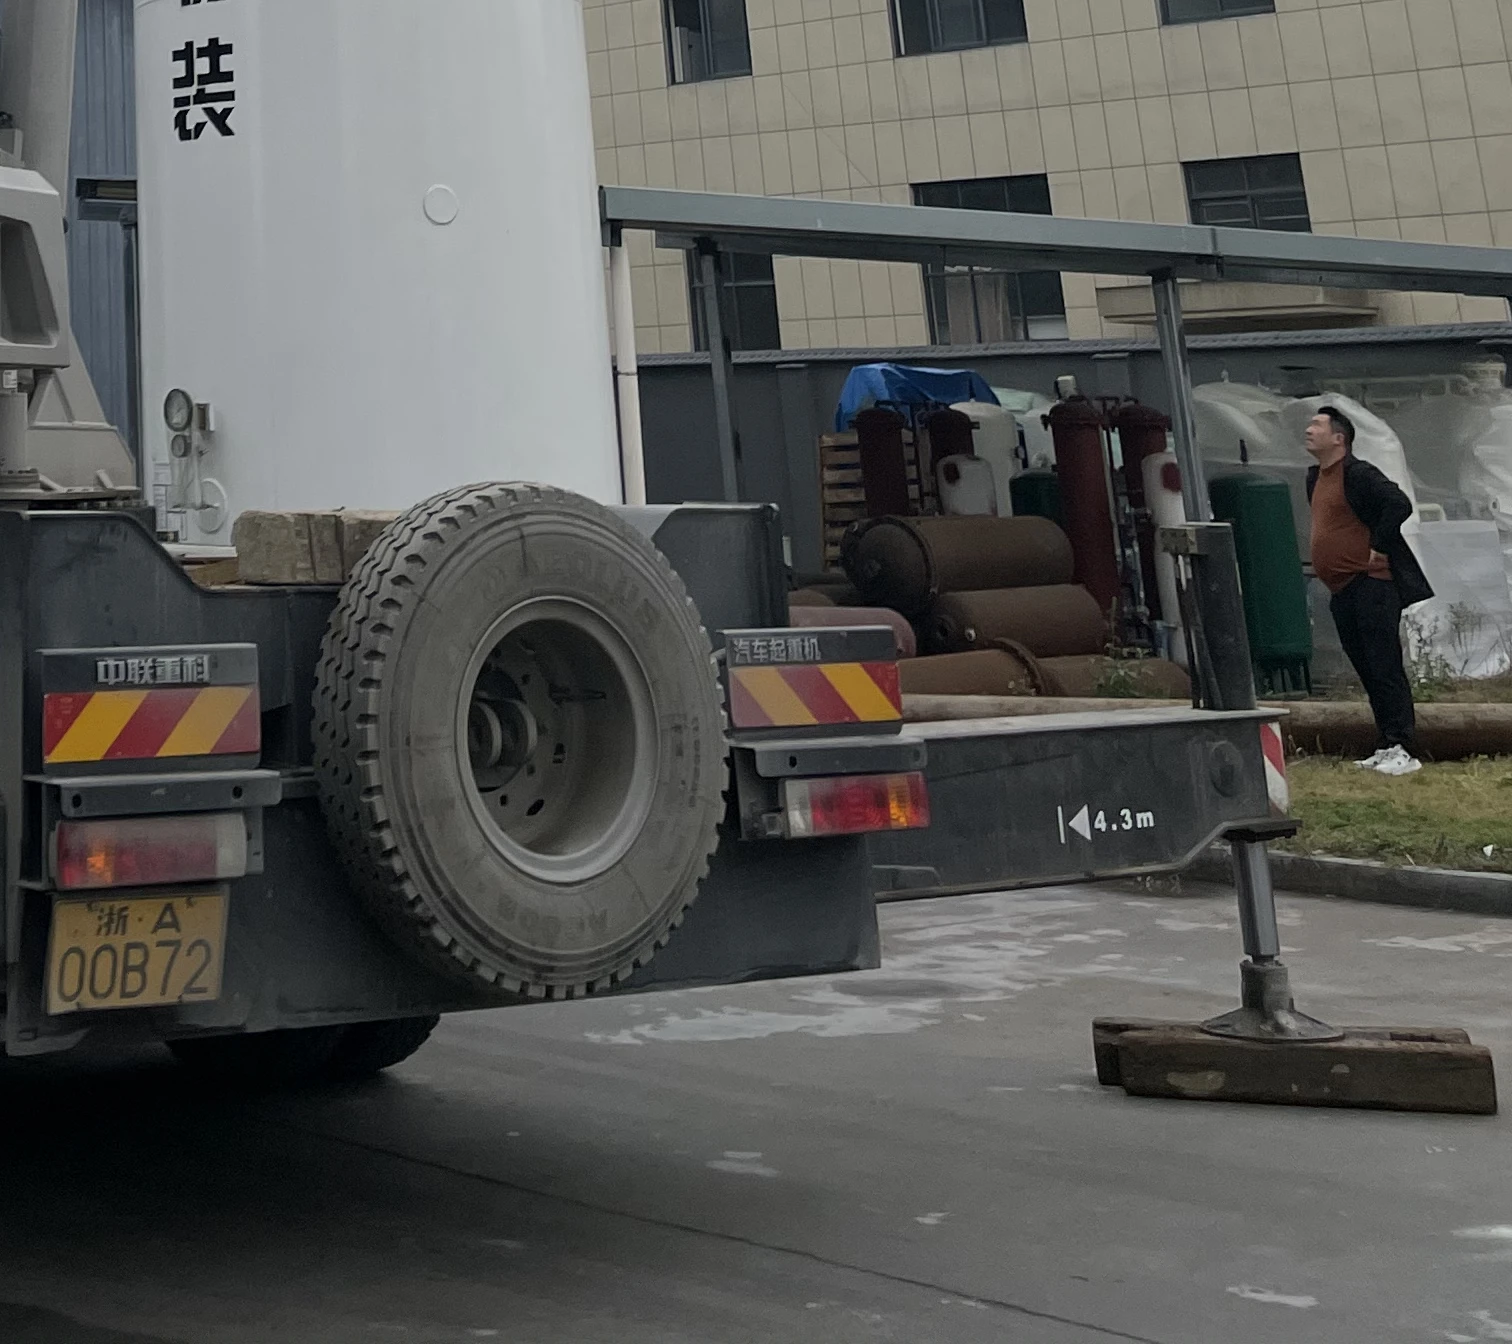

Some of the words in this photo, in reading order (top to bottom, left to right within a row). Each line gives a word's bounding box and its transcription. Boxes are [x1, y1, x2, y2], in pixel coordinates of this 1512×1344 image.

[733, 637, 822, 663] 汽车起重机
[96, 655, 211, 685] 中联重科
[1094, 808, 1155, 832] 4.3m
[58, 939, 211, 1003] 00B72
